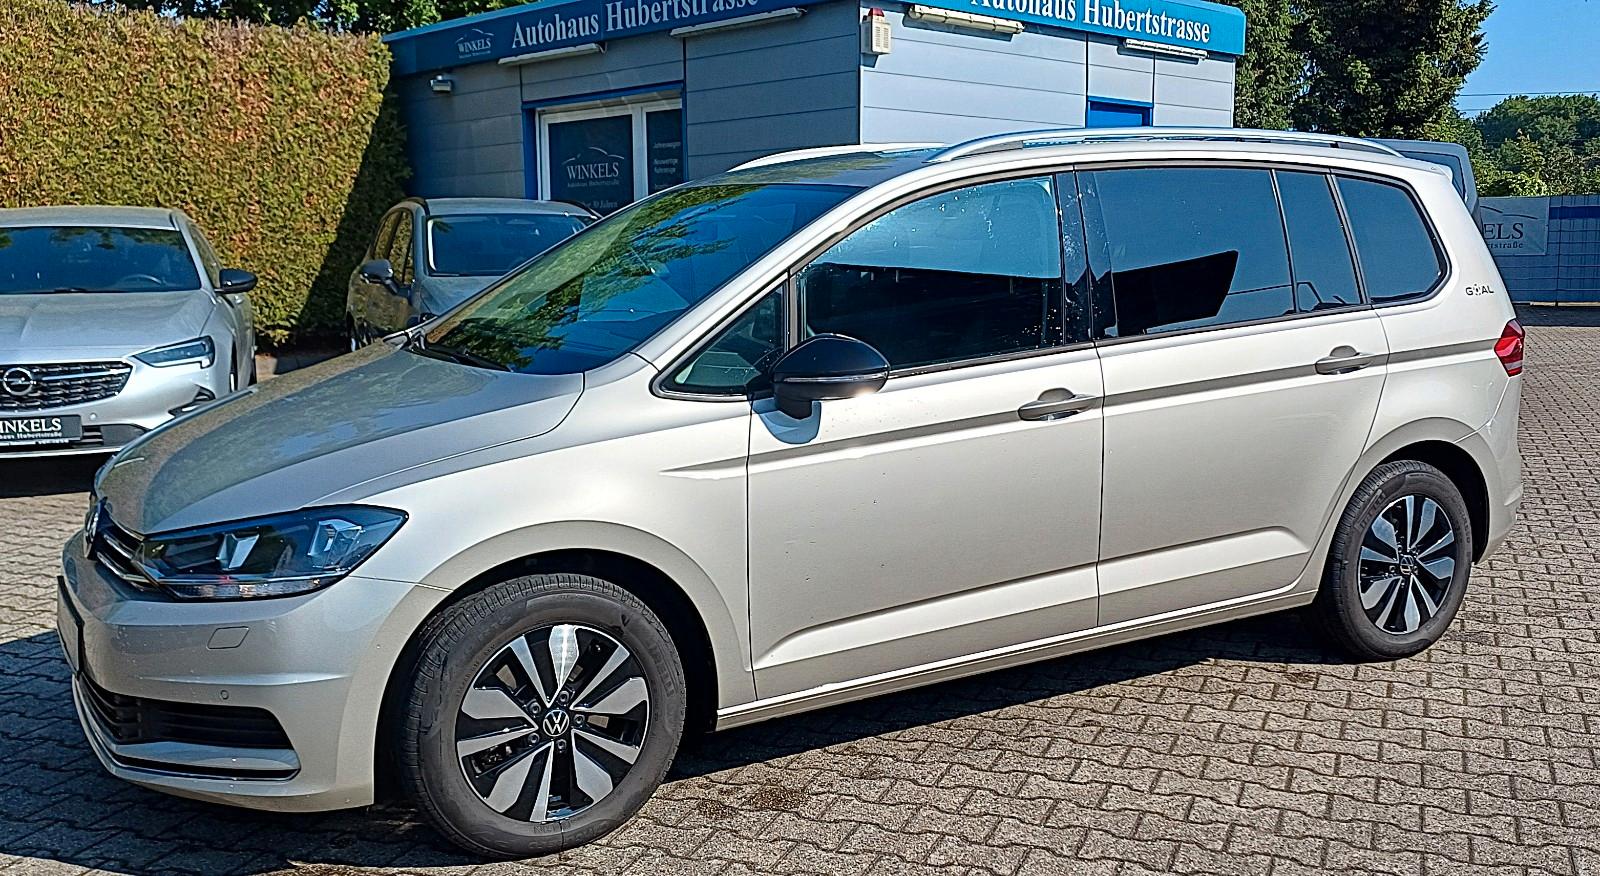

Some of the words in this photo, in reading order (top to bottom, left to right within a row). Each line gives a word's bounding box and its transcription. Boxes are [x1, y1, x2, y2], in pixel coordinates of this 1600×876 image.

[512, 13, 599, 48] Autohaus
[606, 0, 757, 32] Hubertstra
[971, 0, 1076, 21] ohaus
[1083, 1, 1210, 43] Hubertstrasse
[567, 162, 619, 179] WINKELS
